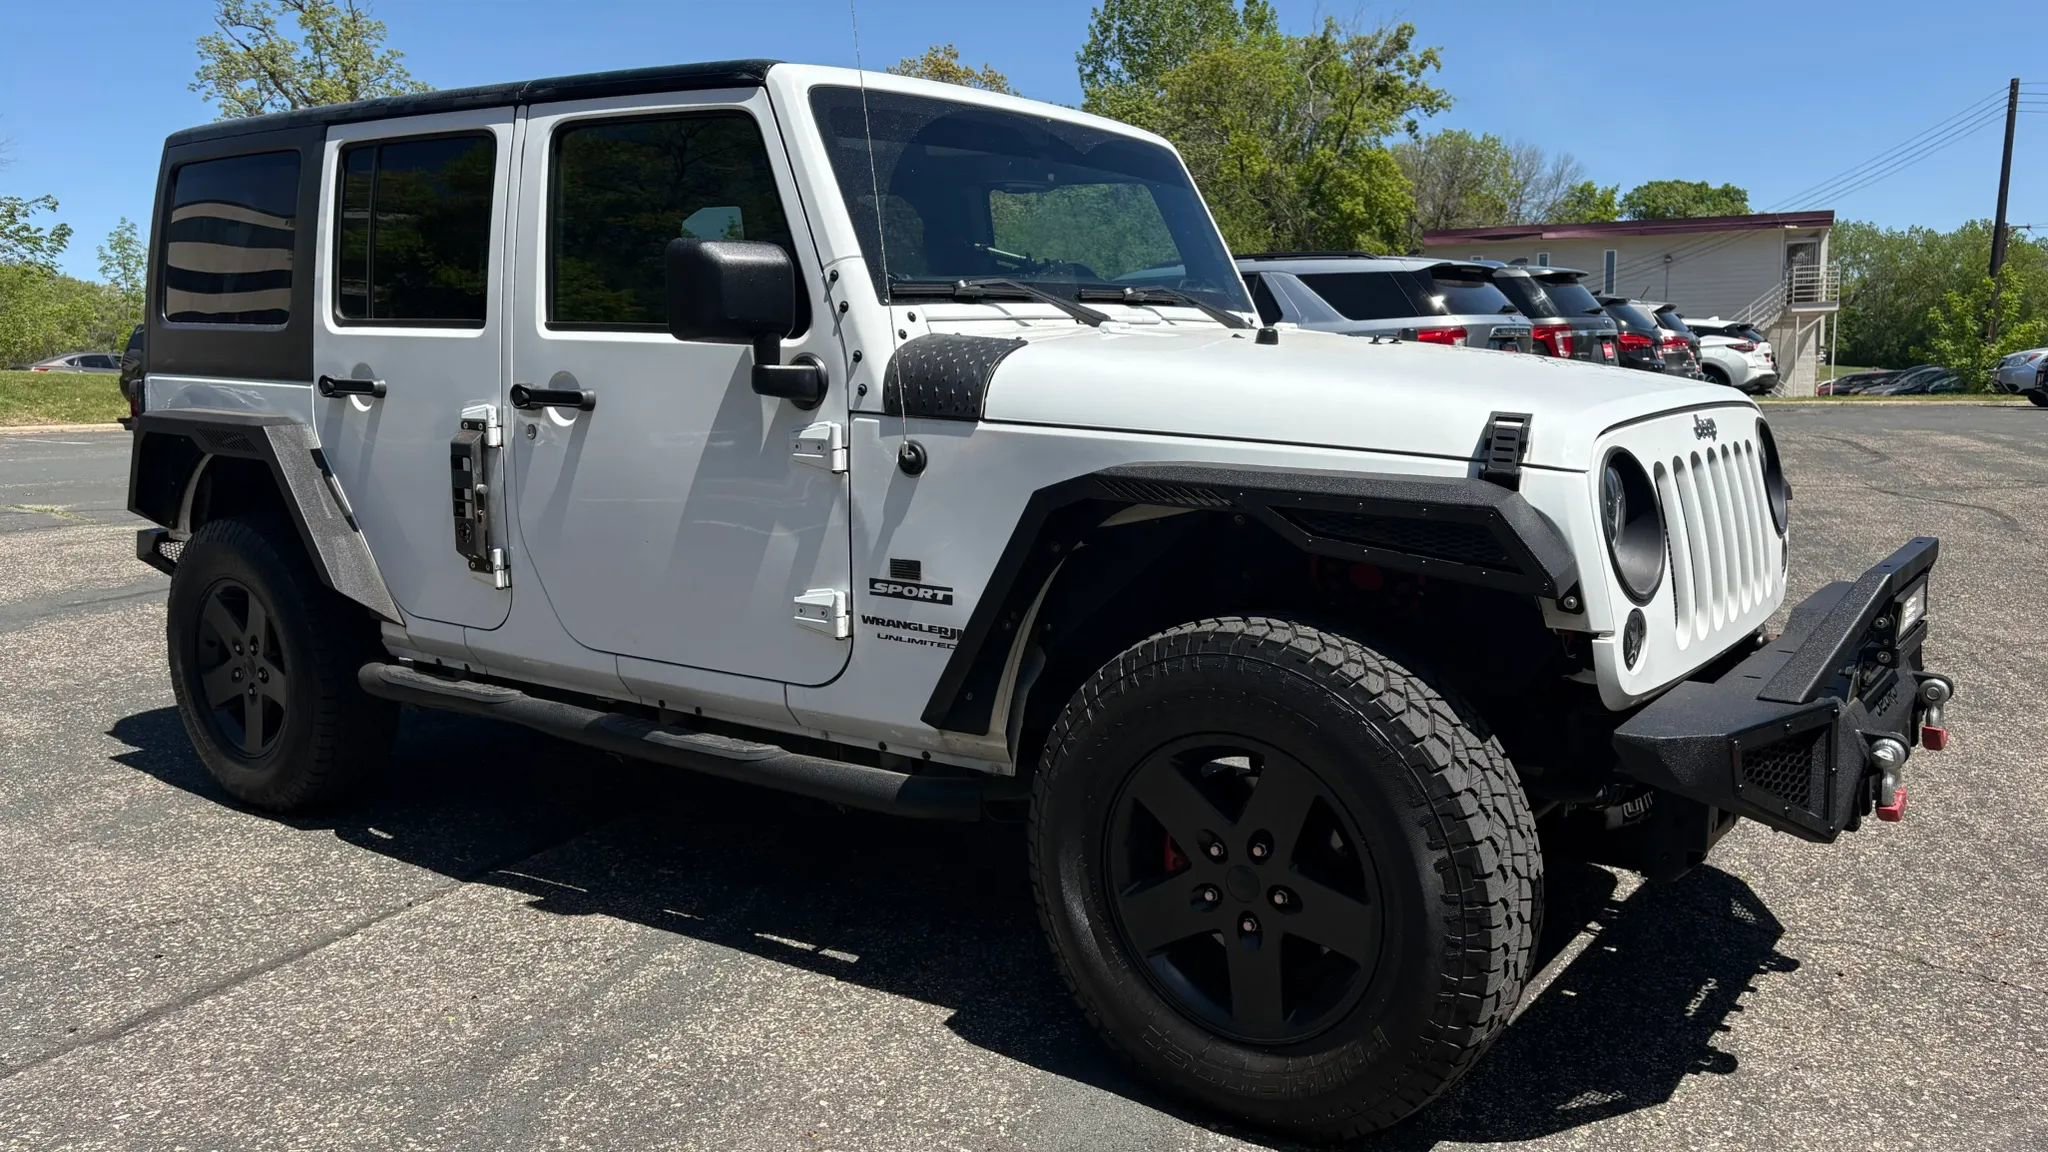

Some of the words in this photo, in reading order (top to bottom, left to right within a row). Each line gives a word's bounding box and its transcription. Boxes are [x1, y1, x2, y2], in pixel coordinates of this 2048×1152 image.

[1693, 414, 1717, 442] Jeep
[870, 581, 952, 602] SPORT
[861, 614, 949, 636] WRANGLER
